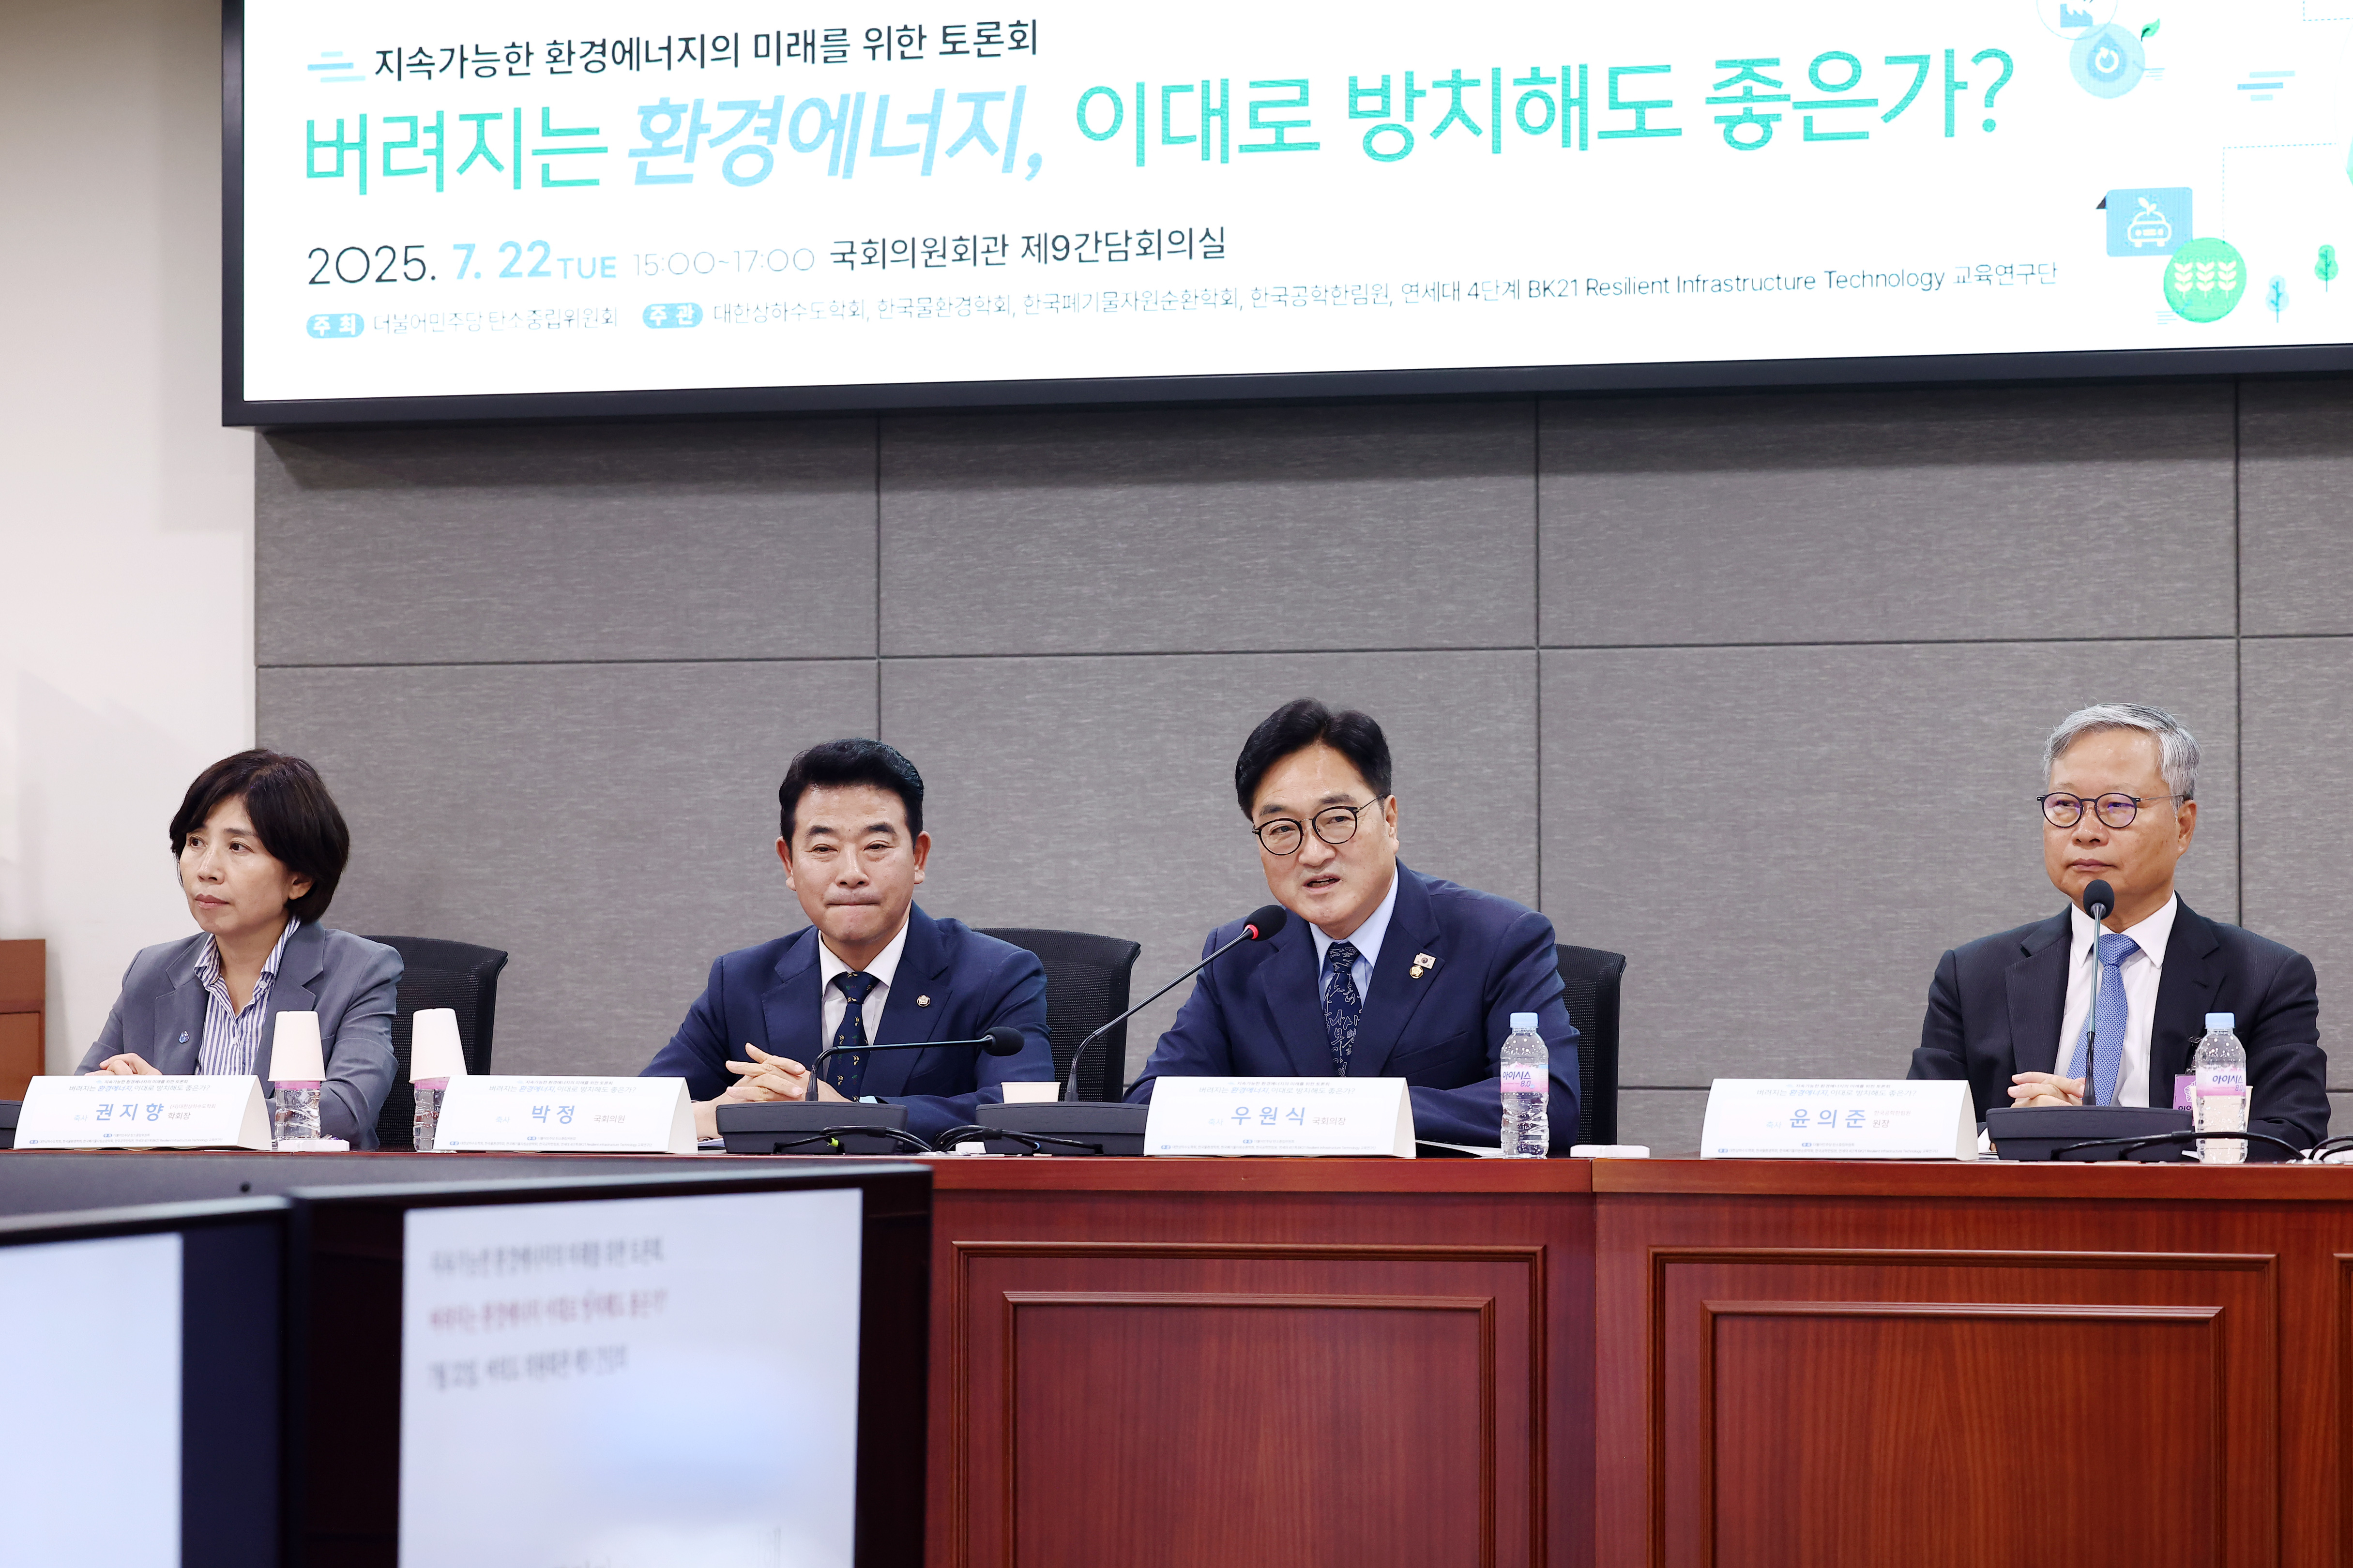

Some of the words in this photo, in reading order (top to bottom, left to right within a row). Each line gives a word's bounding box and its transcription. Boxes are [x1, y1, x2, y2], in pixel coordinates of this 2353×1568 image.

[375, 41, 534, 82] 지속가능한
[546, 32, 738, 75] 환경에너지의
[754, 28, 850, 67] 미래를
[863, 24, 927, 61] 위한
[939, 19, 1036, 58] 토론회
[306, 106, 608, 196] 버려지는
[628, 85, 1042, 187] 환경에너지,
[1077, 78, 1321, 167] 이대로
[1349, 63, 1682, 163] 방치해도
[1705, 48, 2014, 151] 좋은가?
[308, 245, 436, 285] 2025.
[453, 243, 481, 280] 7.
[634, 248, 814, 276] 15:00~17:00
[830, 234, 1009, 271] 국회의원회관
[1021, 226, 1225, 265] 제9간담회의실
[375, 312, 482, 333] 더불어민주당
[489, 308, 616, 331] 탄소중립위원회
[714, 300, 869, 323] 대한상하수도학회,
[879, 295, 1015, 319] 한국물환경학회,
[1024, 288, 1243, 315] 한국폐기물자원순환학회,
[1251, 283, 1392, 308] 한국공학한림원,
[1402, 281, 1459, 303] 연세대
[1468, 279, 1519, 301] 4단계
[1529, 279, 1577, 298] BK21
[1587, 276, 1670, 296] Resilient
[1677, 274, 1816, 293] Infrastructure
[1824, 269, 1945, 291] Technology
[1953, 262, 2058, 286] 교육연구단
[1503, 1071, 1531, 1080] 아이시스
[2213, 1075, 2243, 1084] 아이시스
[1313, 1117, 1346, 1125] 국회의장
[1873, 1119, 1890, 1128] 원장
